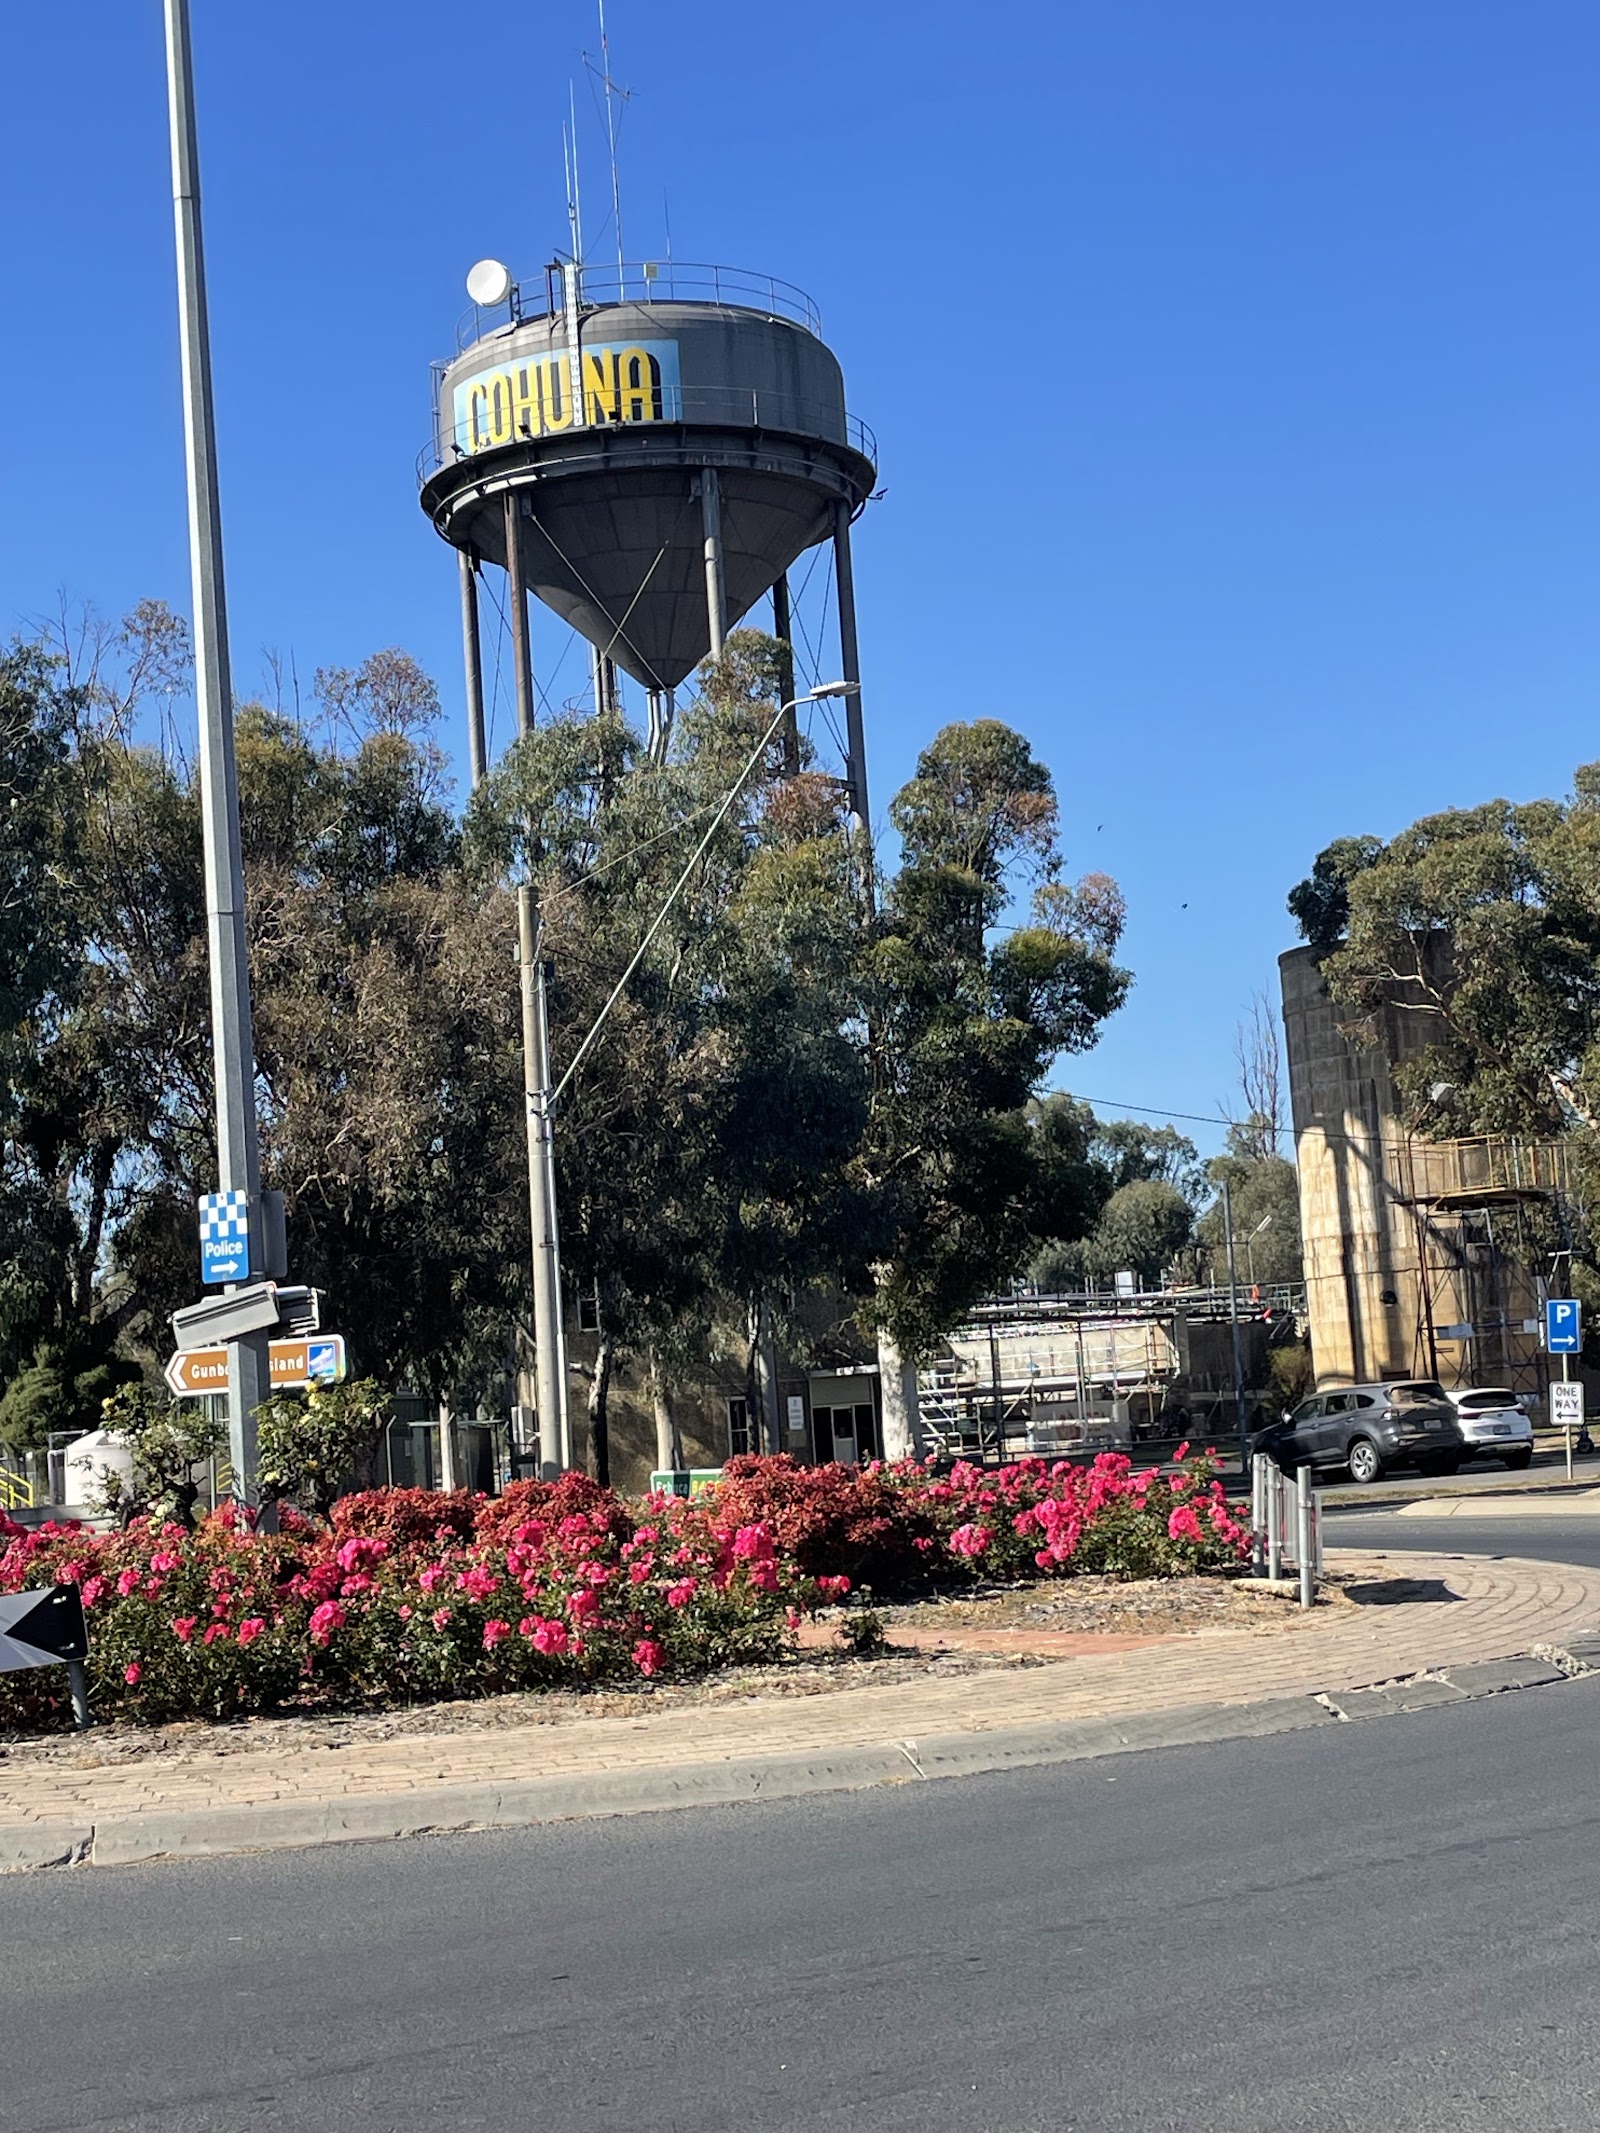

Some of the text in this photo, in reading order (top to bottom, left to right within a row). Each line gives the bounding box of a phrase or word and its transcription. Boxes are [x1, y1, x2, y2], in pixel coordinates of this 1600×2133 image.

[466, 346, 656, 451] COHUNA
[205, 1240, 243, 1258] Police
[1556, 1304, 1571, 1323] P
[269, 1355, 304, 1372] sland
[1556, 1386, 1577, 1397] ONE
[1554, 1400, 1579, 1409] WAY
